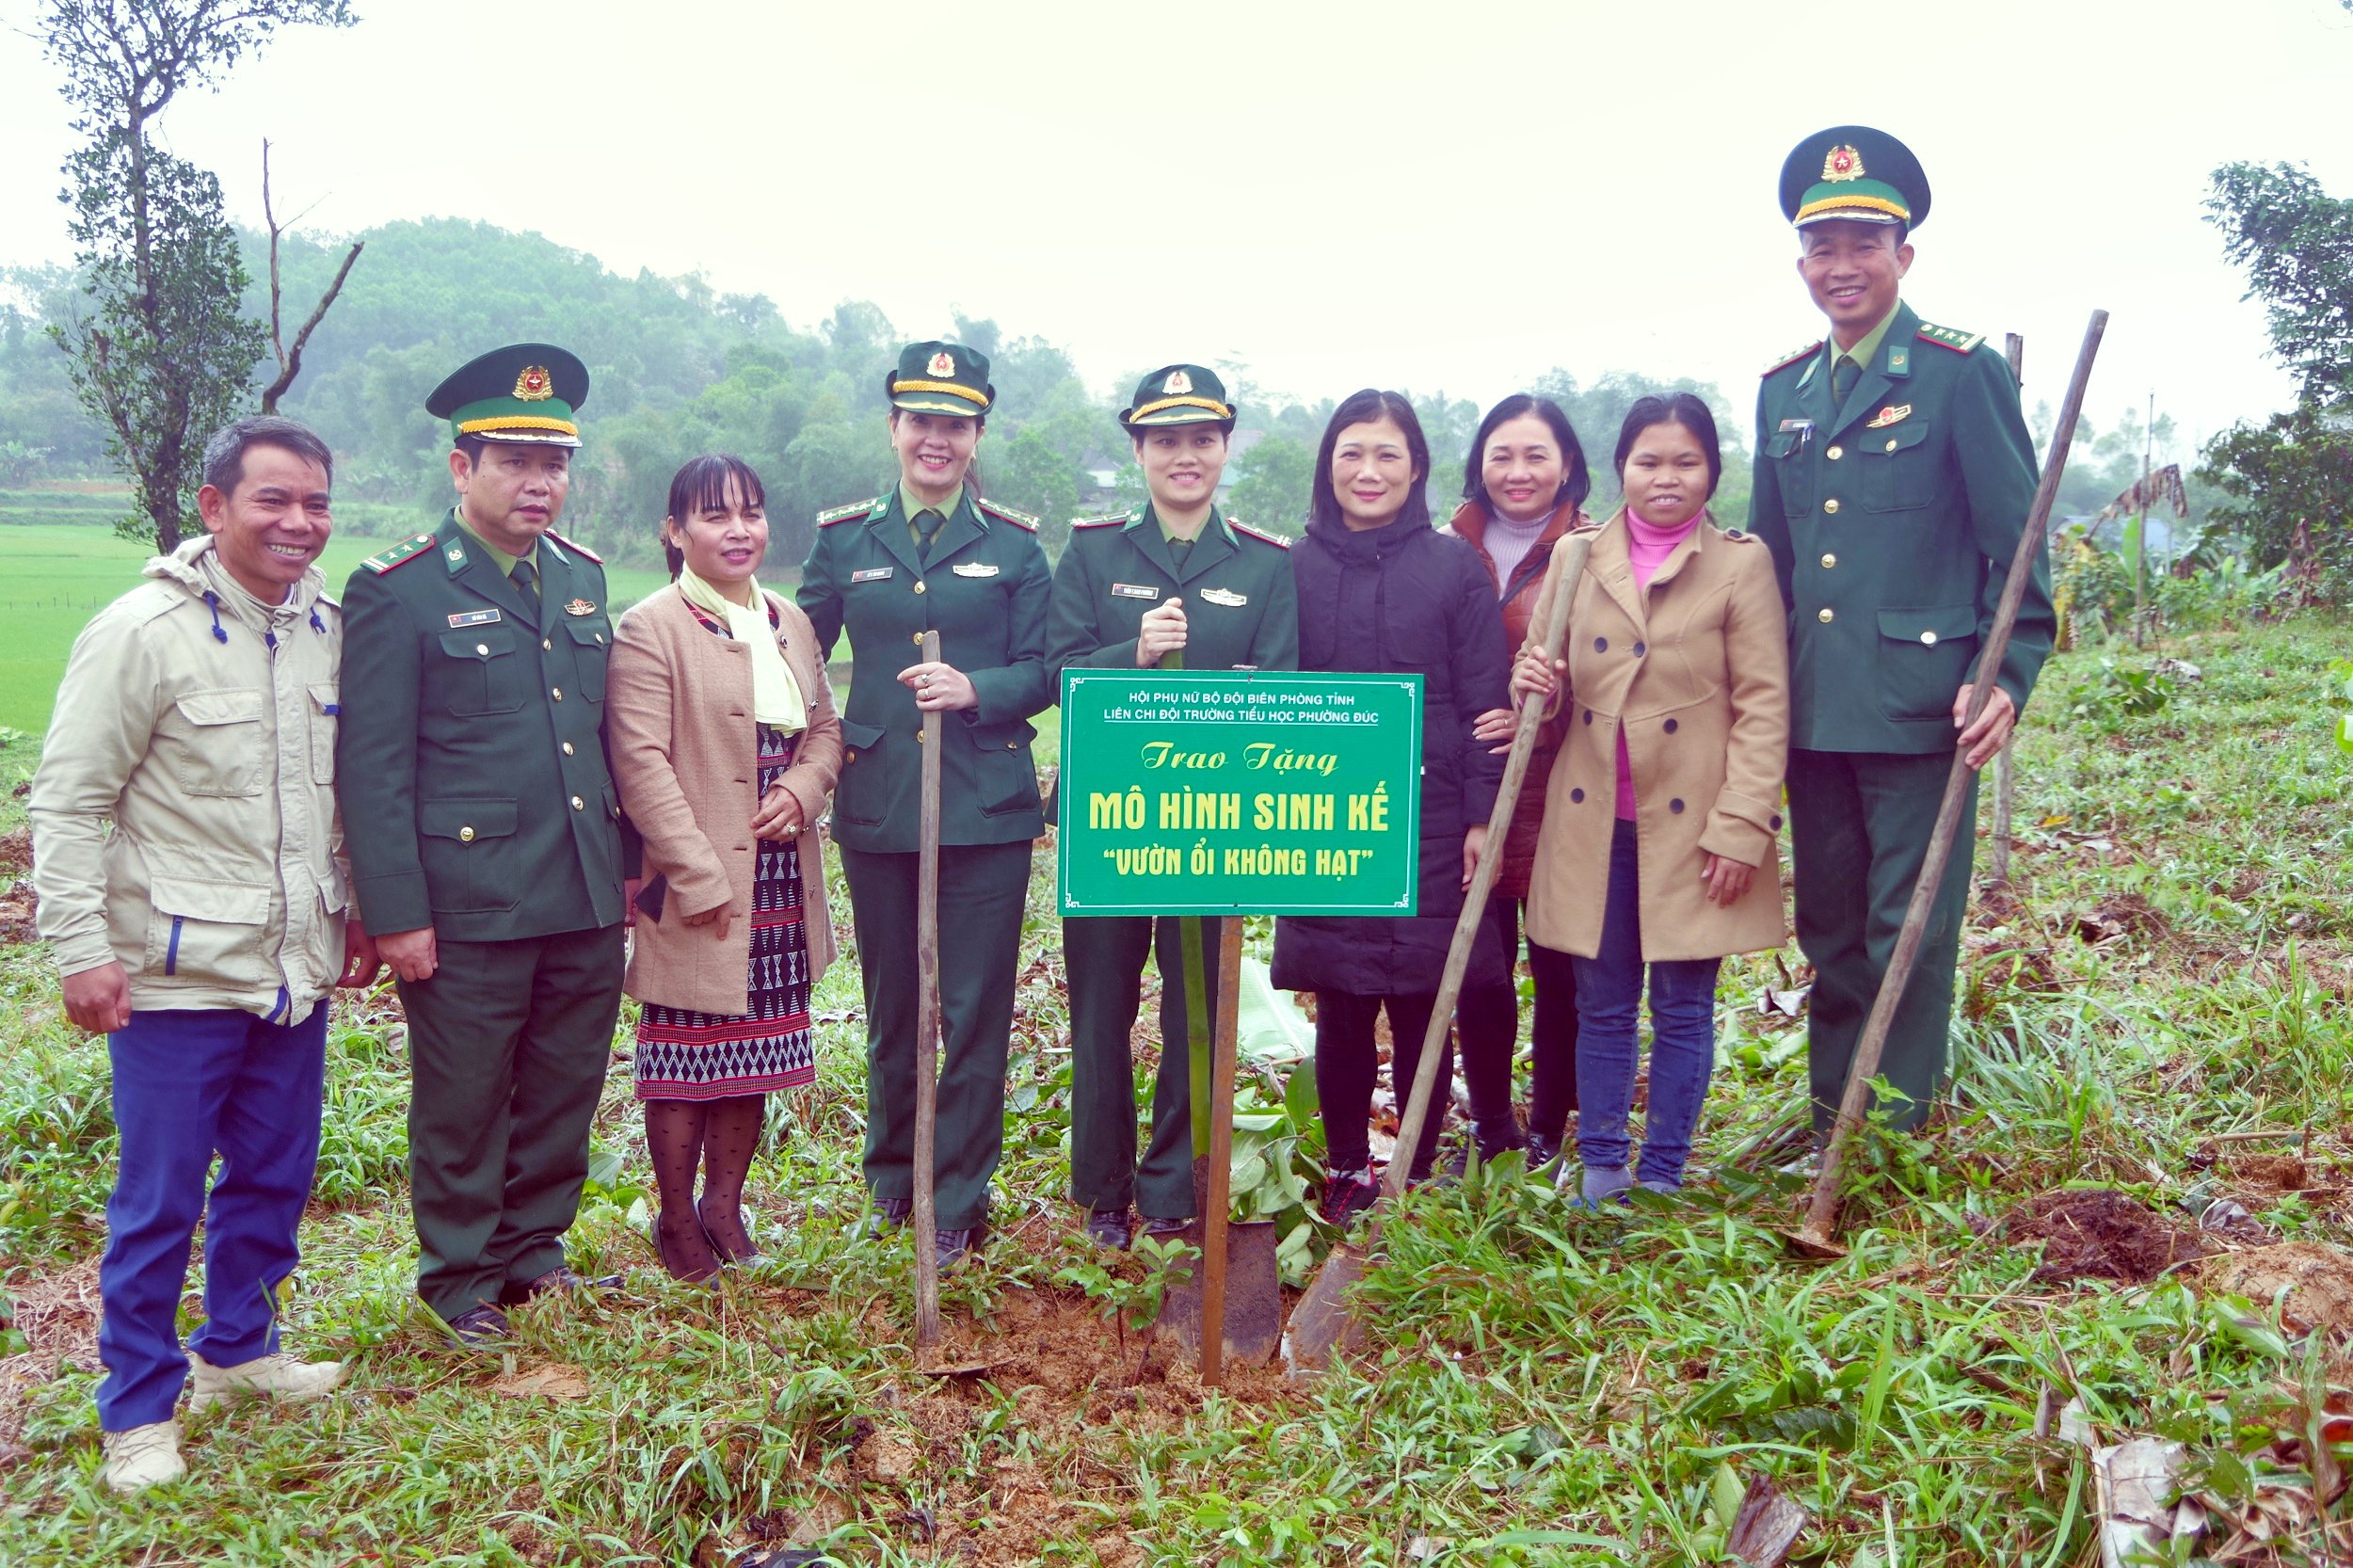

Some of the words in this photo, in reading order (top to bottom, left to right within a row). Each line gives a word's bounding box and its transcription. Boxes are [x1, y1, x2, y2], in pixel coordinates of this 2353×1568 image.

[1103, 706, 1131, 720] LIÊN
[1134, 709, 1156, 720] CHI
[1159, 707, 1180, 721] ĐỘI
[1183, 708, 1235, 721] TRƯỜNG
[1238, 706, 1266, 721] TIỂU
[1268, 711, 1295, 723] HỌC
[1298, 709, 1350, 723] PHƯỜNG
[1353, 710, 1379, 723] ĐÚC
[1128, 690, 1150, 705] HỘI
[1153, 692, 1179, 705] PHỤ
[1182, 691, 1200, 704] NỮ
[1202, 691, 1221, 705] BỘ
[1223, 691, 1244, 705] ĐỘI
[1247, 691, 1276, 705] BIÊN
[1279, 692, 1322, 705] PHÒNG
[1326, 691, 1354, 706] TỈNH
[1141, 741, 1228, 770] Trao
[1242, 742, 1339, 777] Tặng
[1089, 785, 1146, 830] MÔ
[1159, 785, 1241, 830] HÌNH
[1253, 792, 1335, 831] SINH
[1347, 780, 1390, 831] KẾ
[1190, 837, 1215, 876] ỔI
[1224, 843, 1306, 876] KHÔNG
